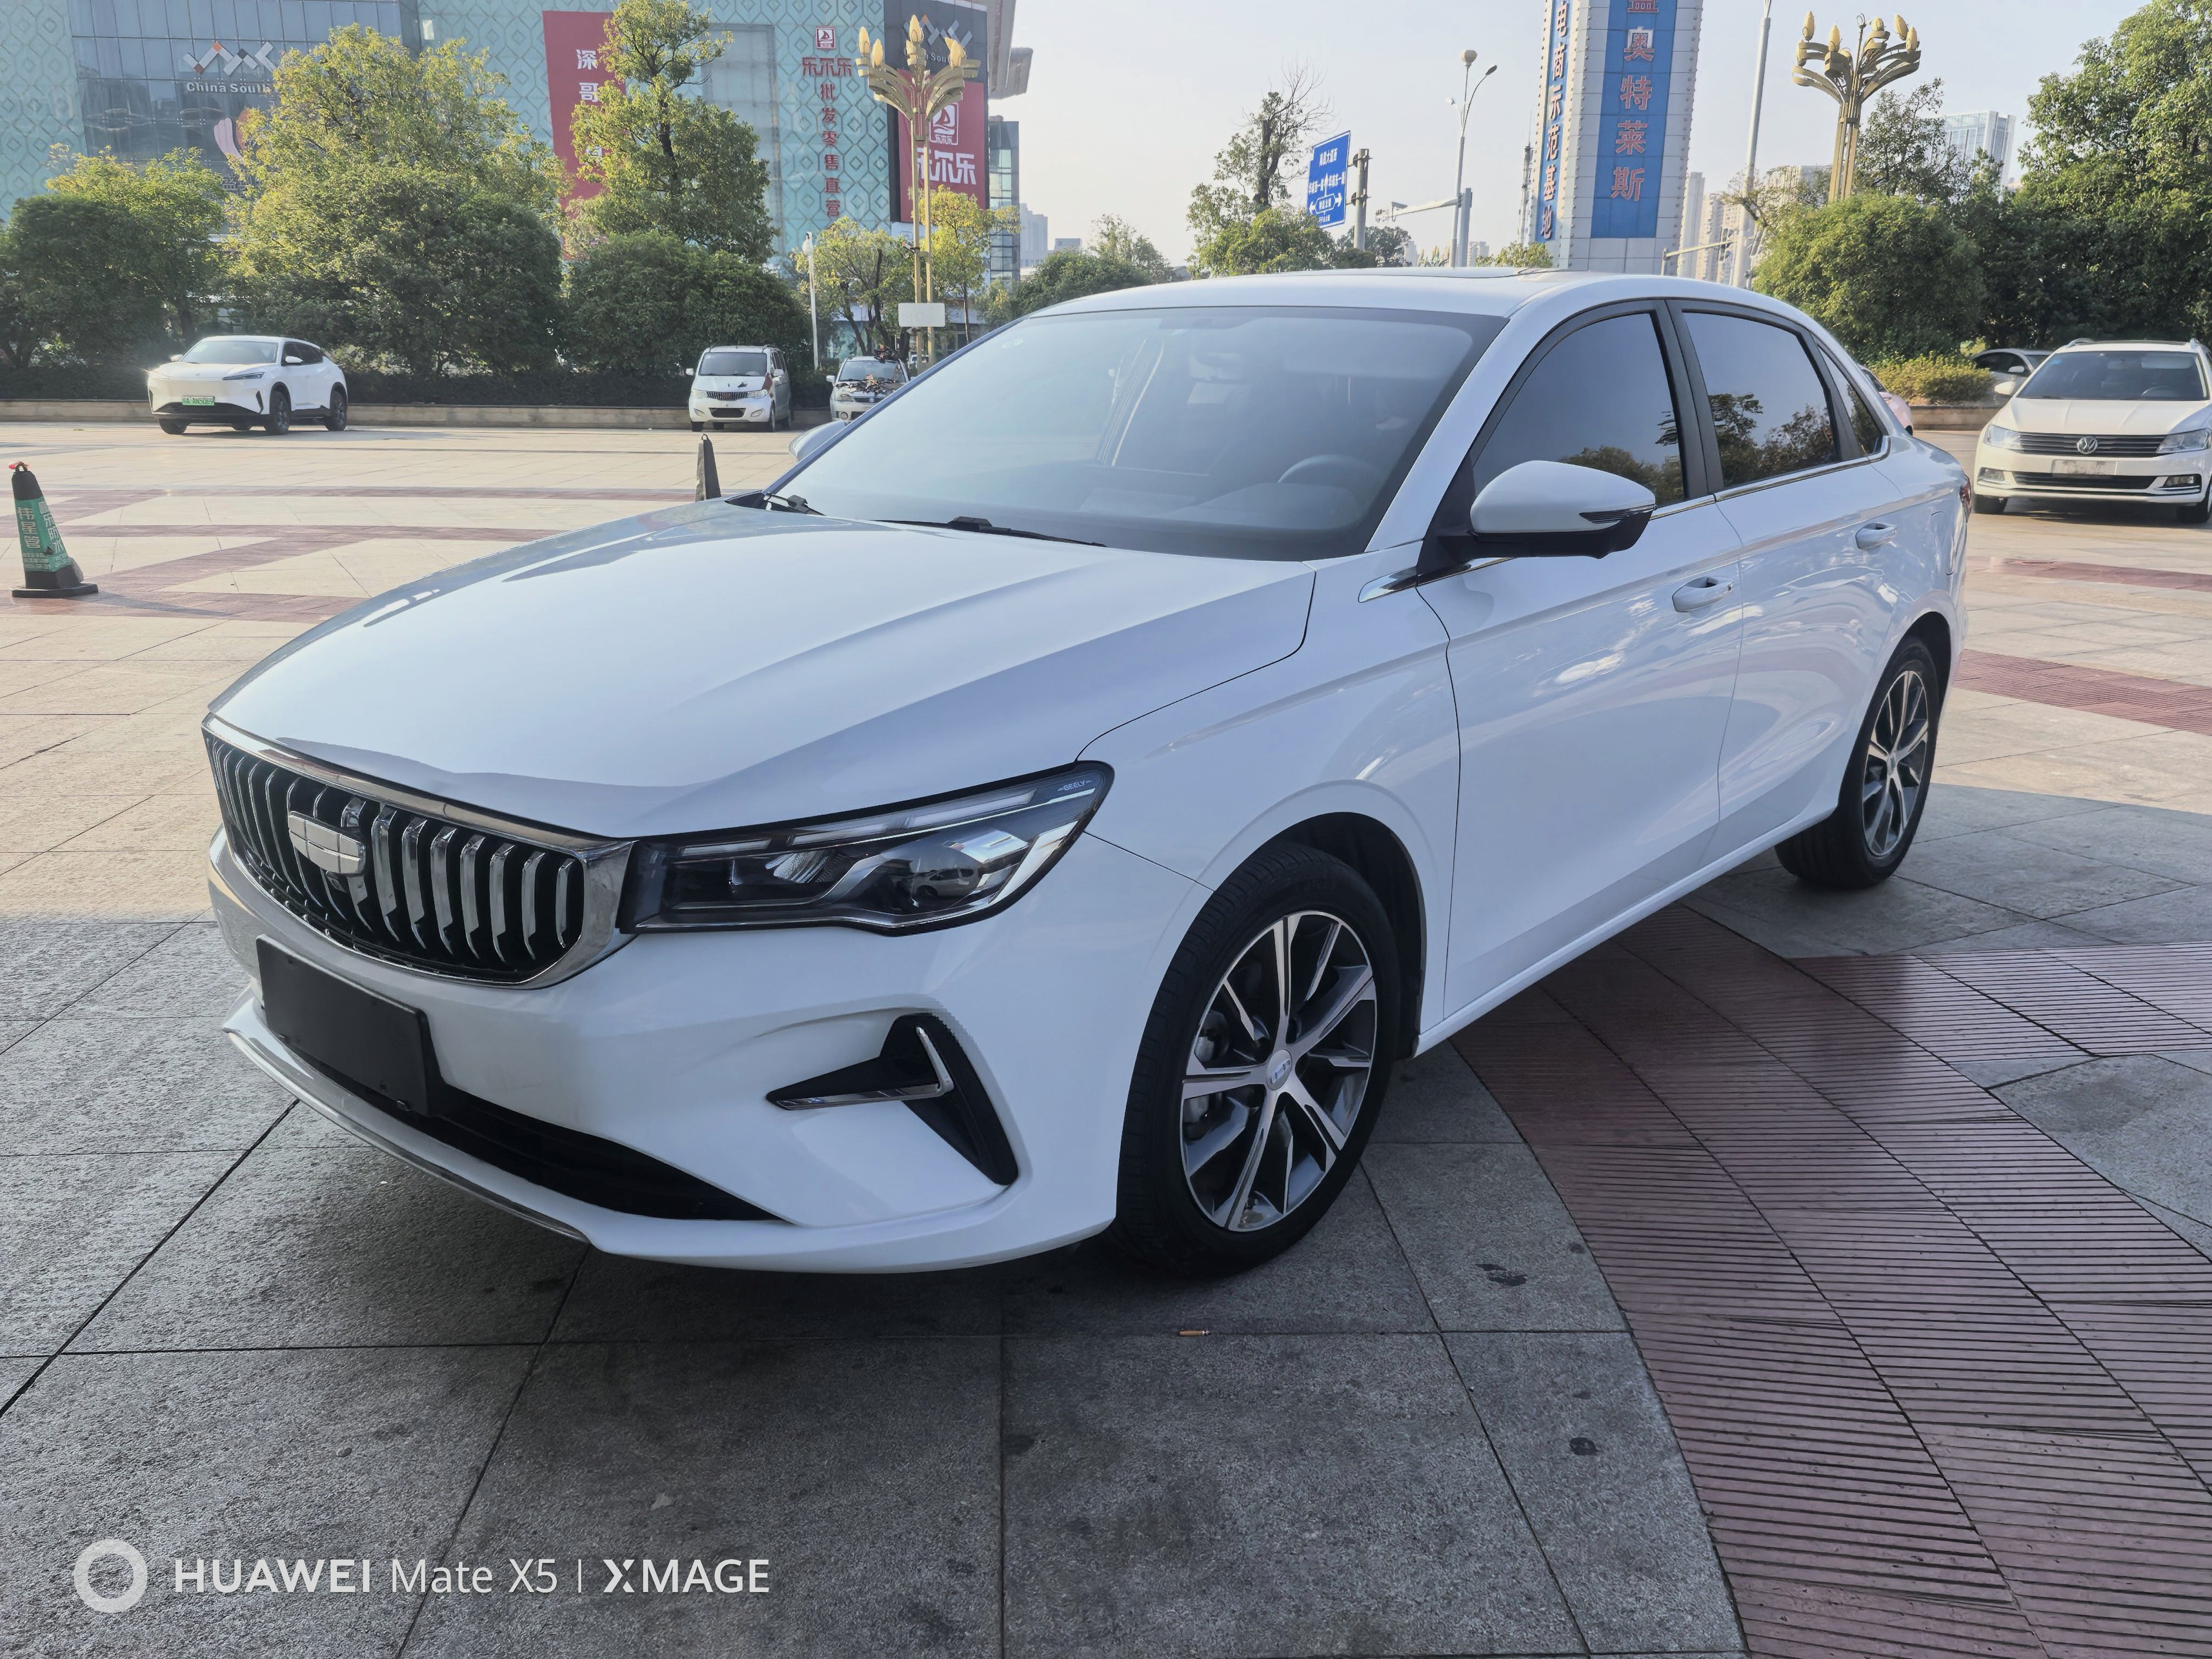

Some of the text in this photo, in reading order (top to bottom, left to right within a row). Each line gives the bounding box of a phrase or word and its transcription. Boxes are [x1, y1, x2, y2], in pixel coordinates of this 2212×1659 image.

[186, 83, 226, 92] China
[820, 83, 840, 217] 批发零售直营
[39, 501, 64, 553] 乐防水
[1063, 780, 1085, 791] GEELY
